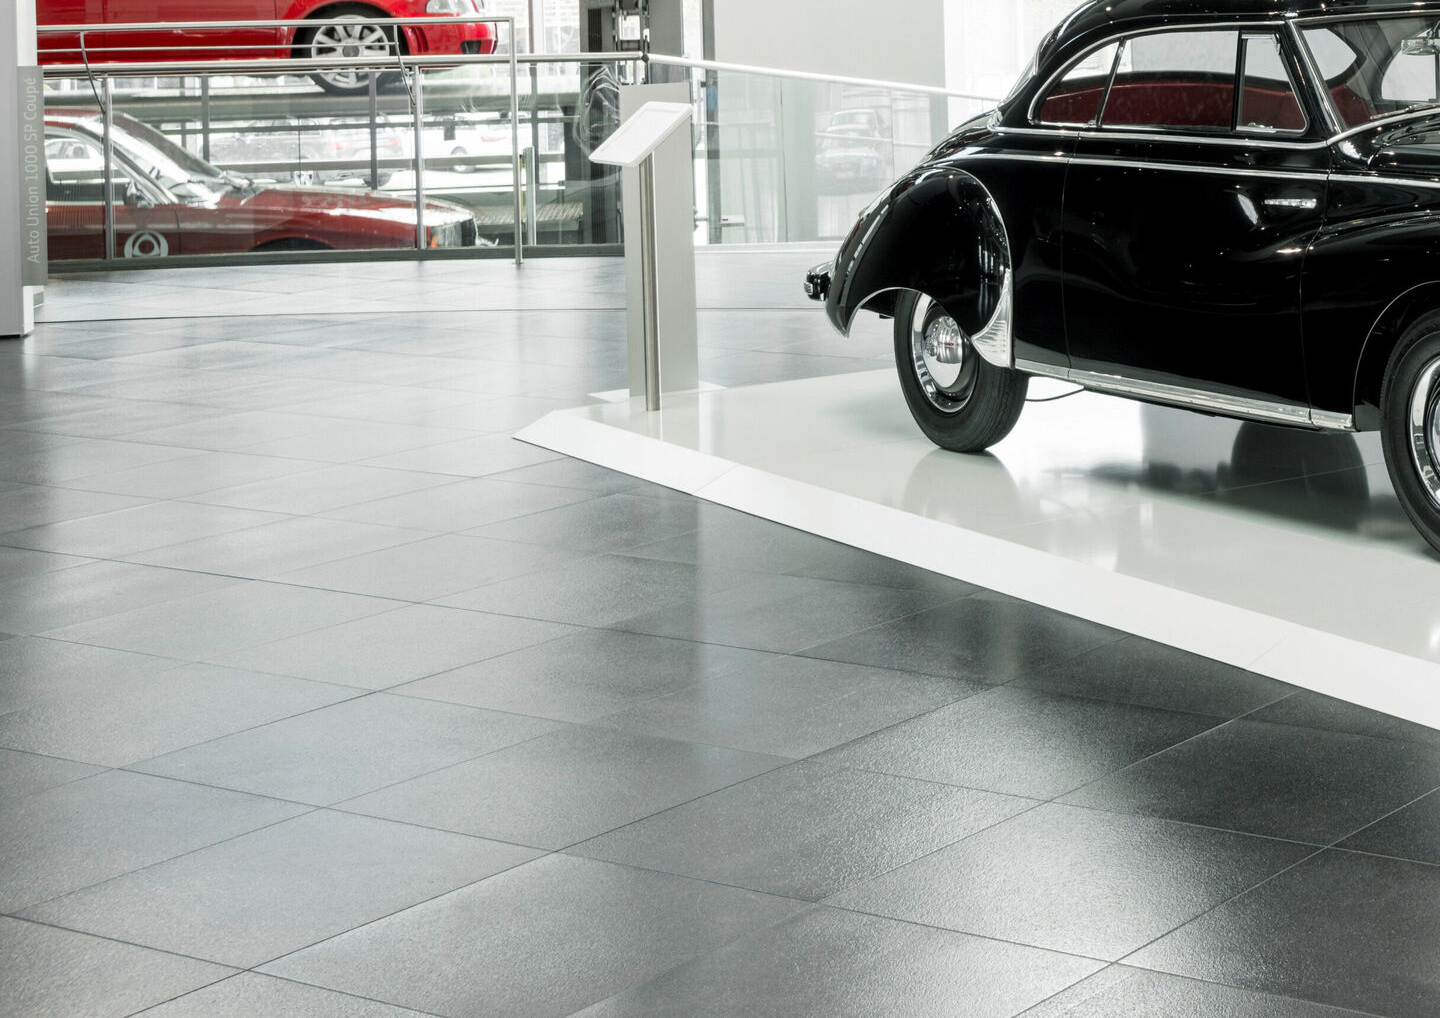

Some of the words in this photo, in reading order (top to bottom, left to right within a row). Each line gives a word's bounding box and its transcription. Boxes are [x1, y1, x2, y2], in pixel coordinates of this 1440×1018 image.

[24, 77, 40, 120] Coupé
[24, 124, 38, 142] SP
[24, 145, 39, 181] 1000
[25, 186, 40, 226] Union
[27, 230, 40, 263] Auto
